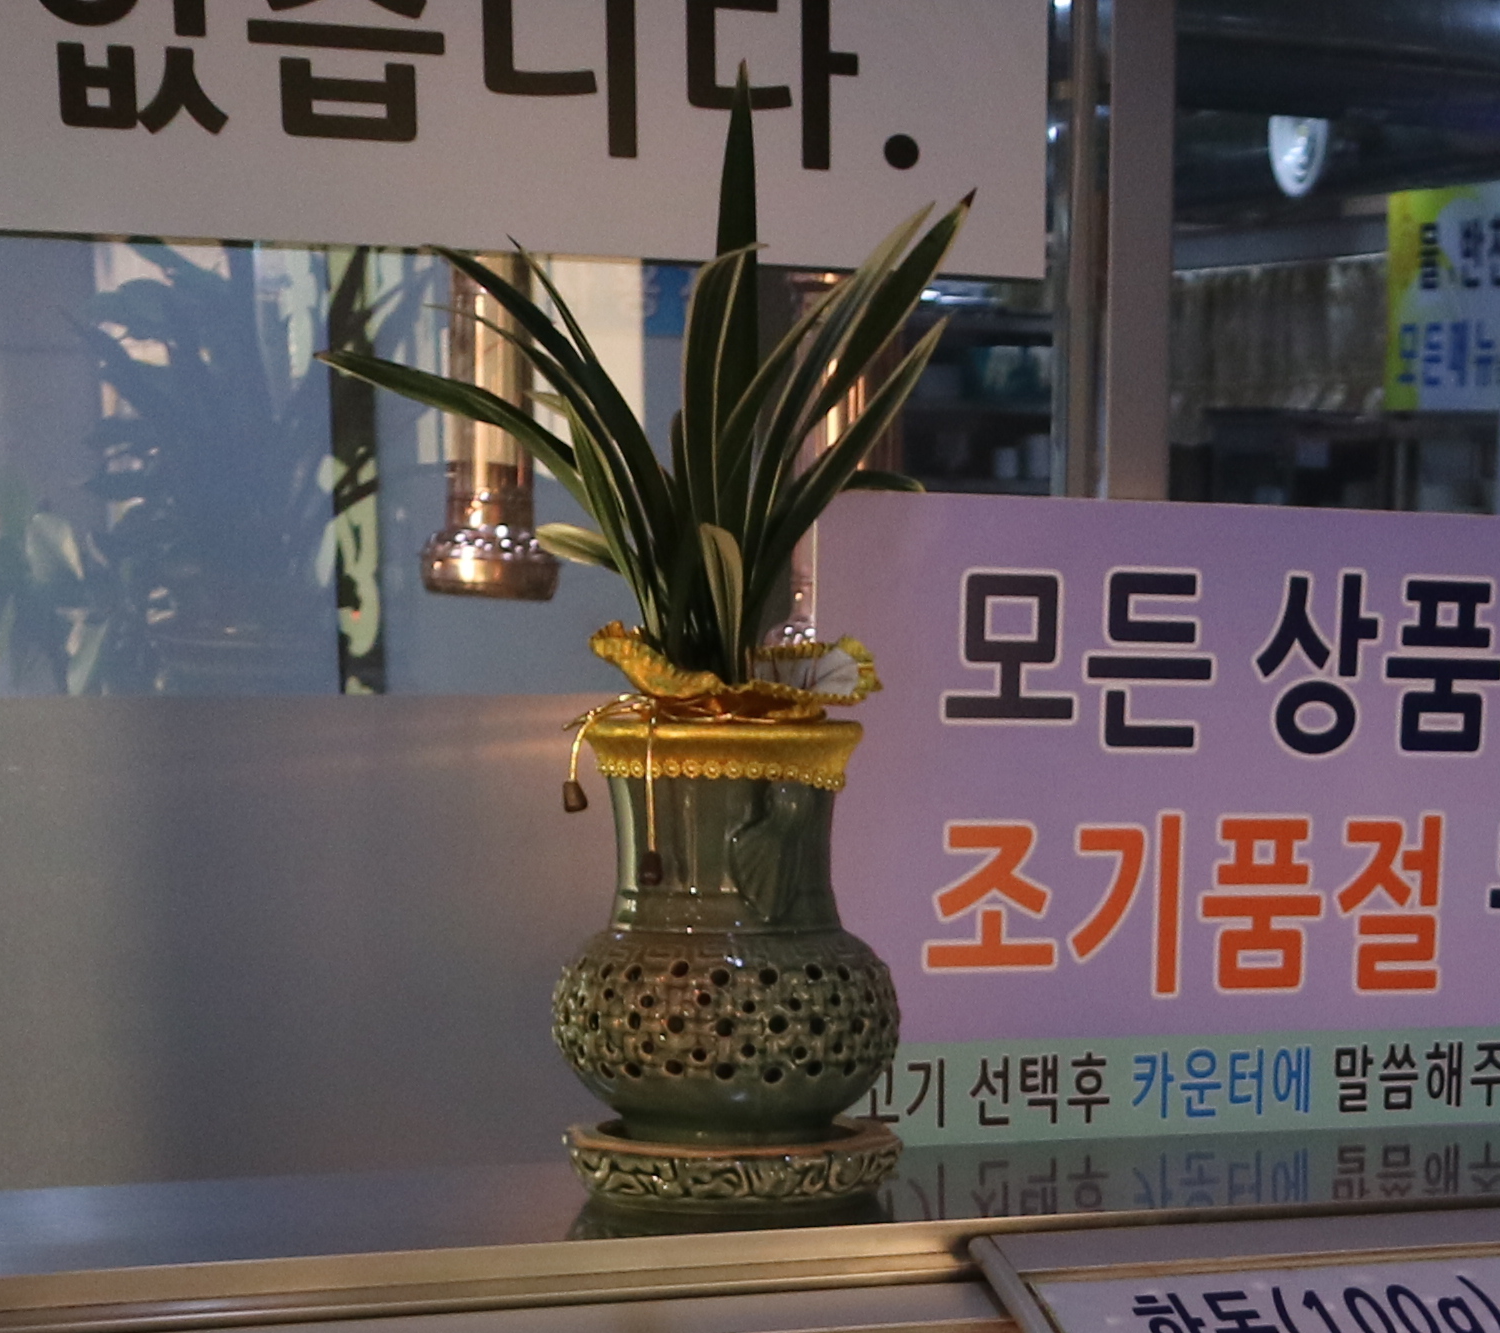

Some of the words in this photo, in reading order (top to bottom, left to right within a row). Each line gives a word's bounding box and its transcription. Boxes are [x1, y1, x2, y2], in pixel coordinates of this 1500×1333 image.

[38, 0, 920, 171] 없습니다.
[941, 568, 1215, 753] 모든
[923, 812, 1442, 998] 조기품절
[969, 1051, 1112, 1127] 선택후
[1130, 1045, 1313, 1120] 카운터에
